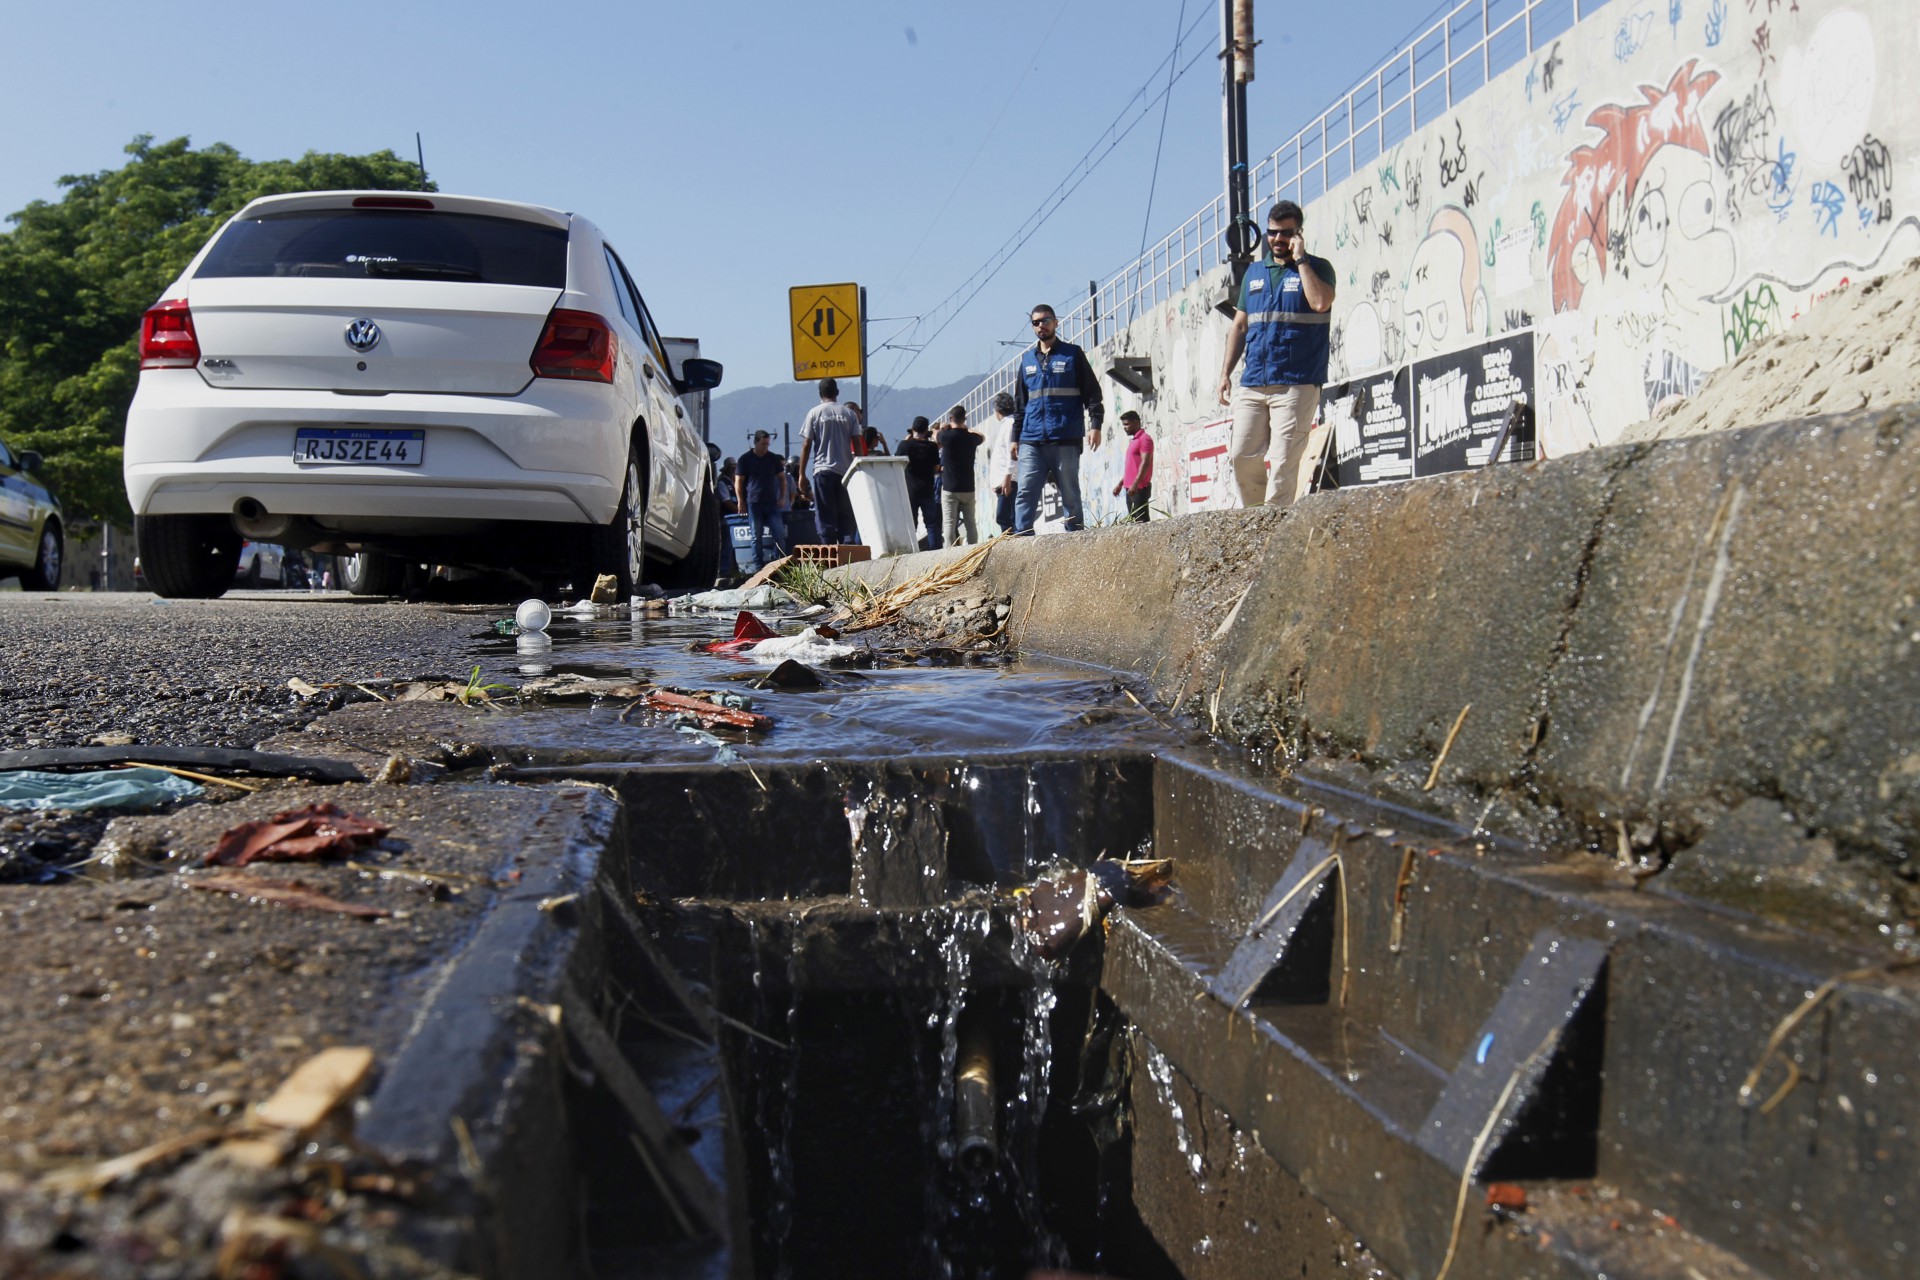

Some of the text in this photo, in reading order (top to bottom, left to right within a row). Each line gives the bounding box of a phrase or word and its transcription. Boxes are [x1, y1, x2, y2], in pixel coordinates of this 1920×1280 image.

[811, 360, 845, 369] A 100 m
[1419, 373, 1468, 447] FUNK
[306, 439, 407, 460] RJS2E44
